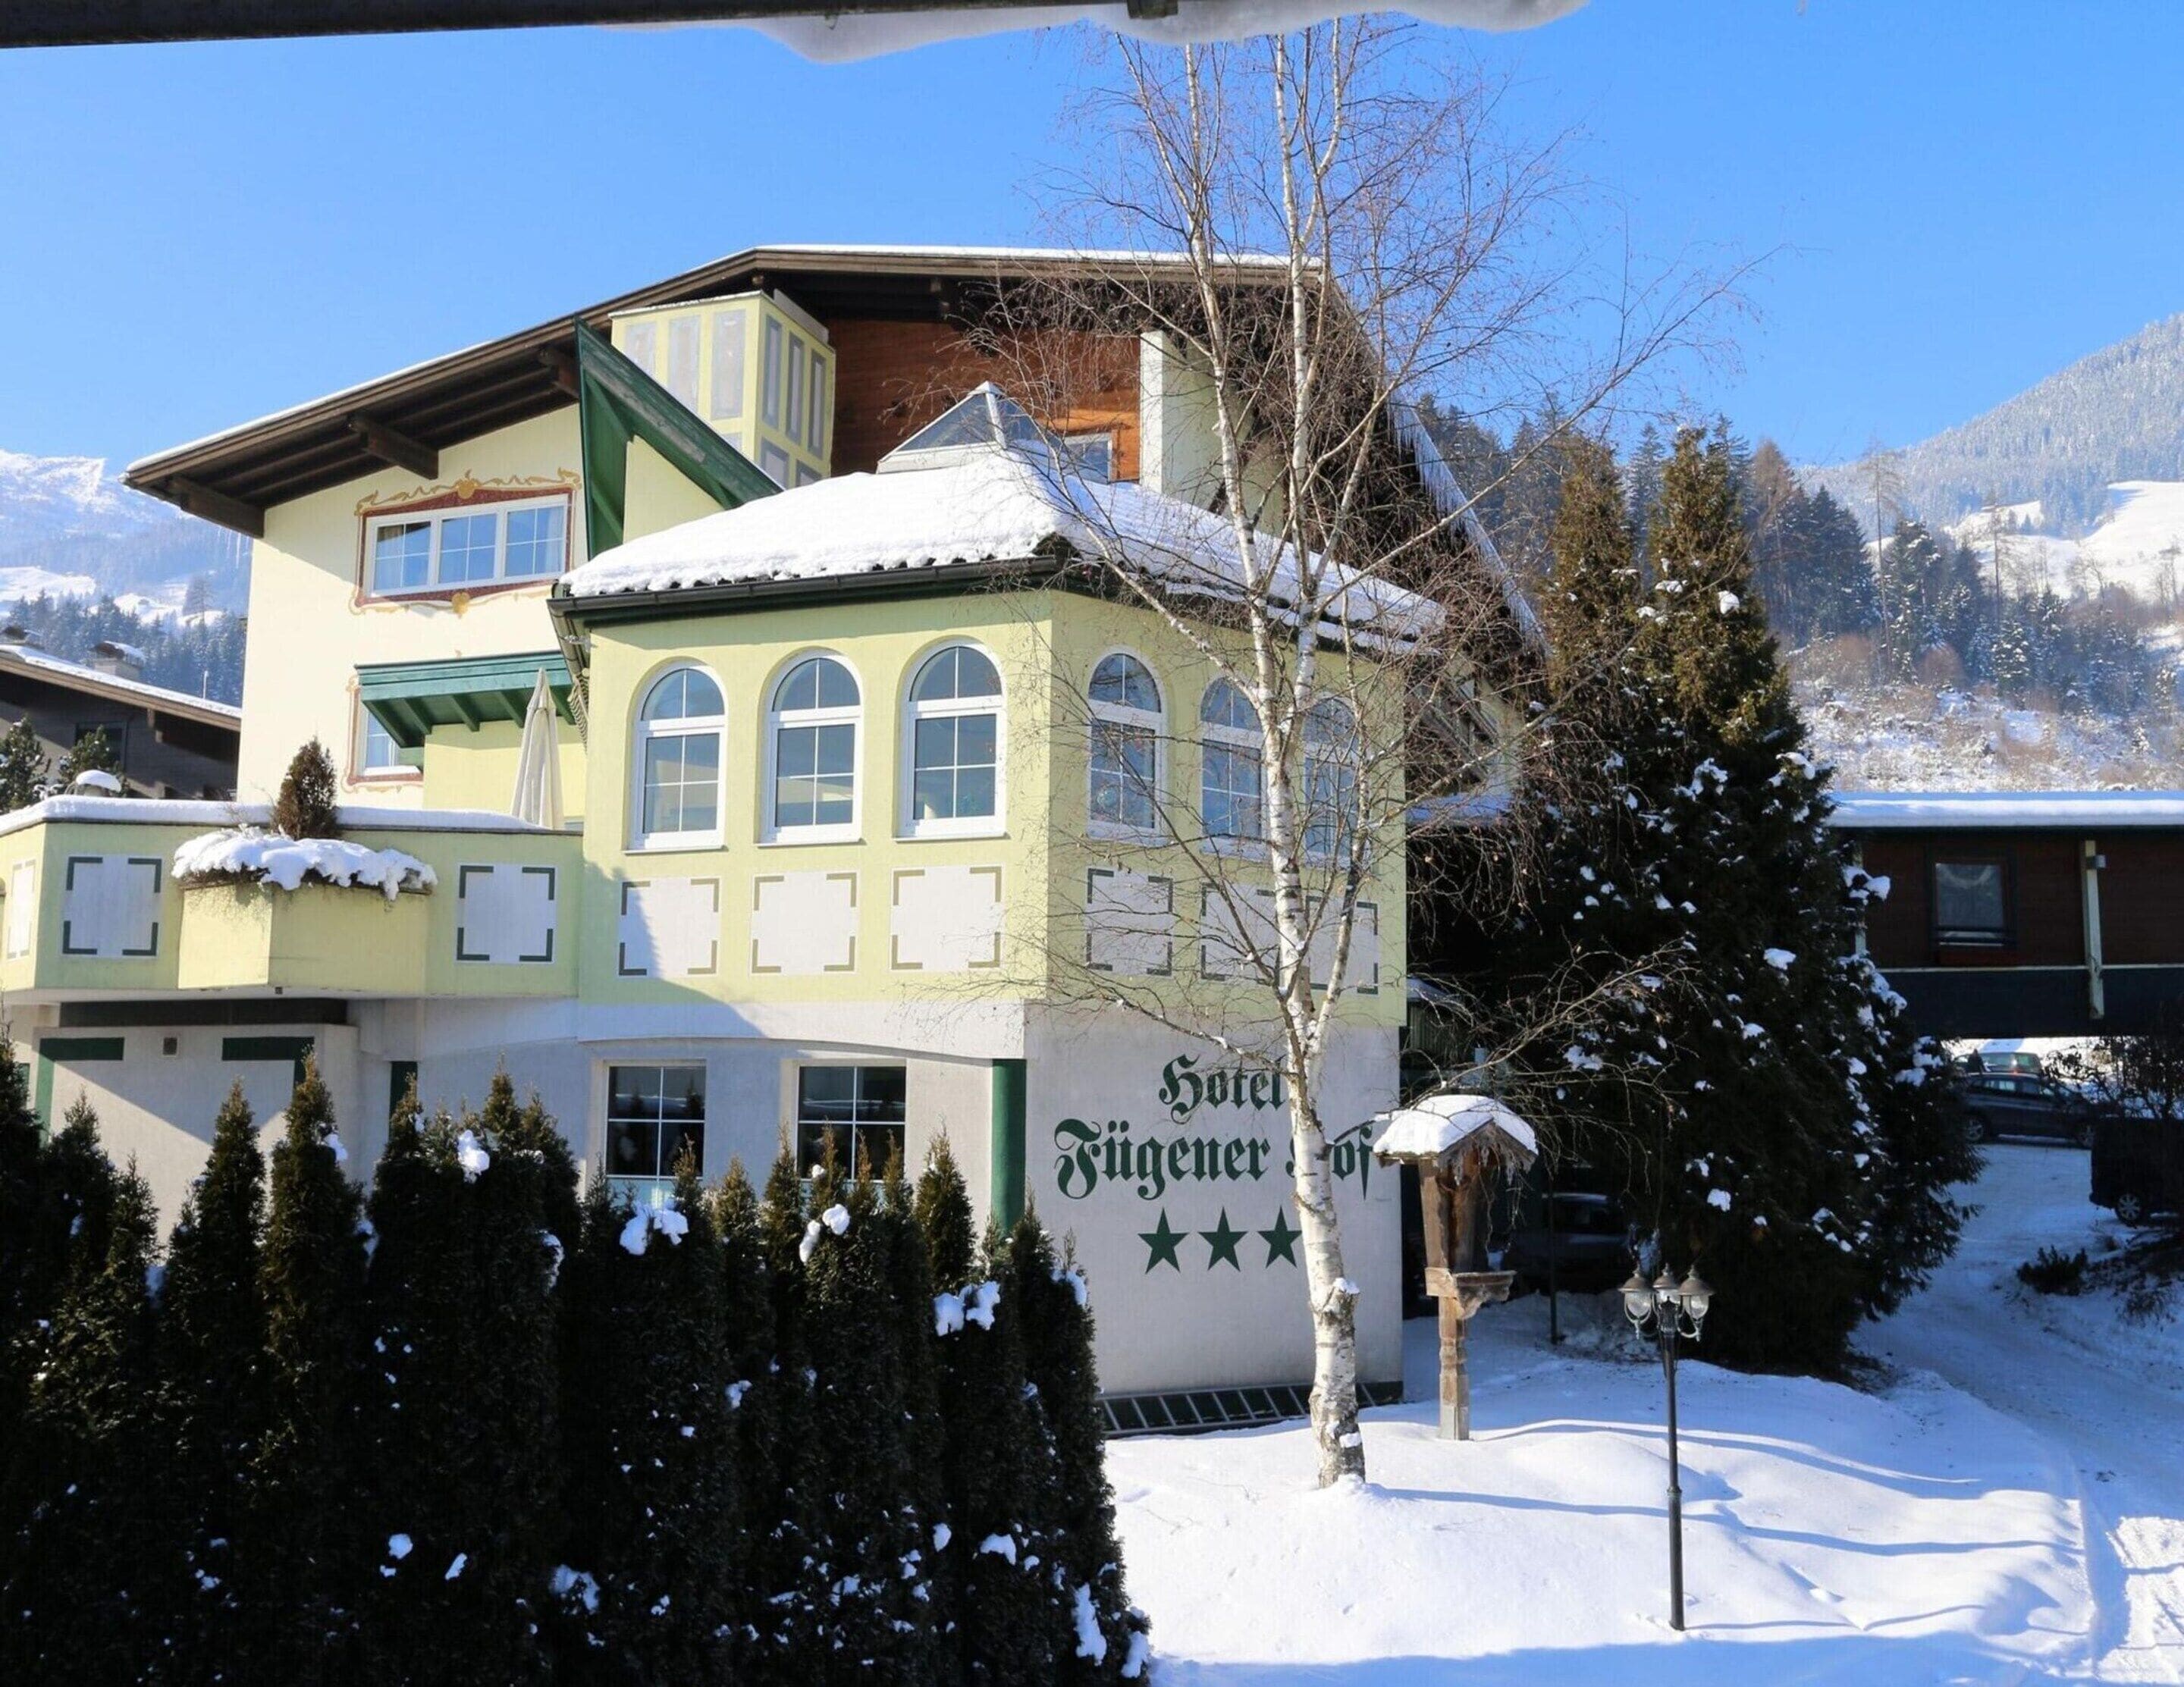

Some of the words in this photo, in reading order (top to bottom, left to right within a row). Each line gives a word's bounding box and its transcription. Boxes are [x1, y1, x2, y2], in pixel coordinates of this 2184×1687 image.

[1159, 1054, 1286, 1124] Hotel
[1053, 1118, 1270, 1200] Fügener
[1285, 1126, 1373, 1200] of
